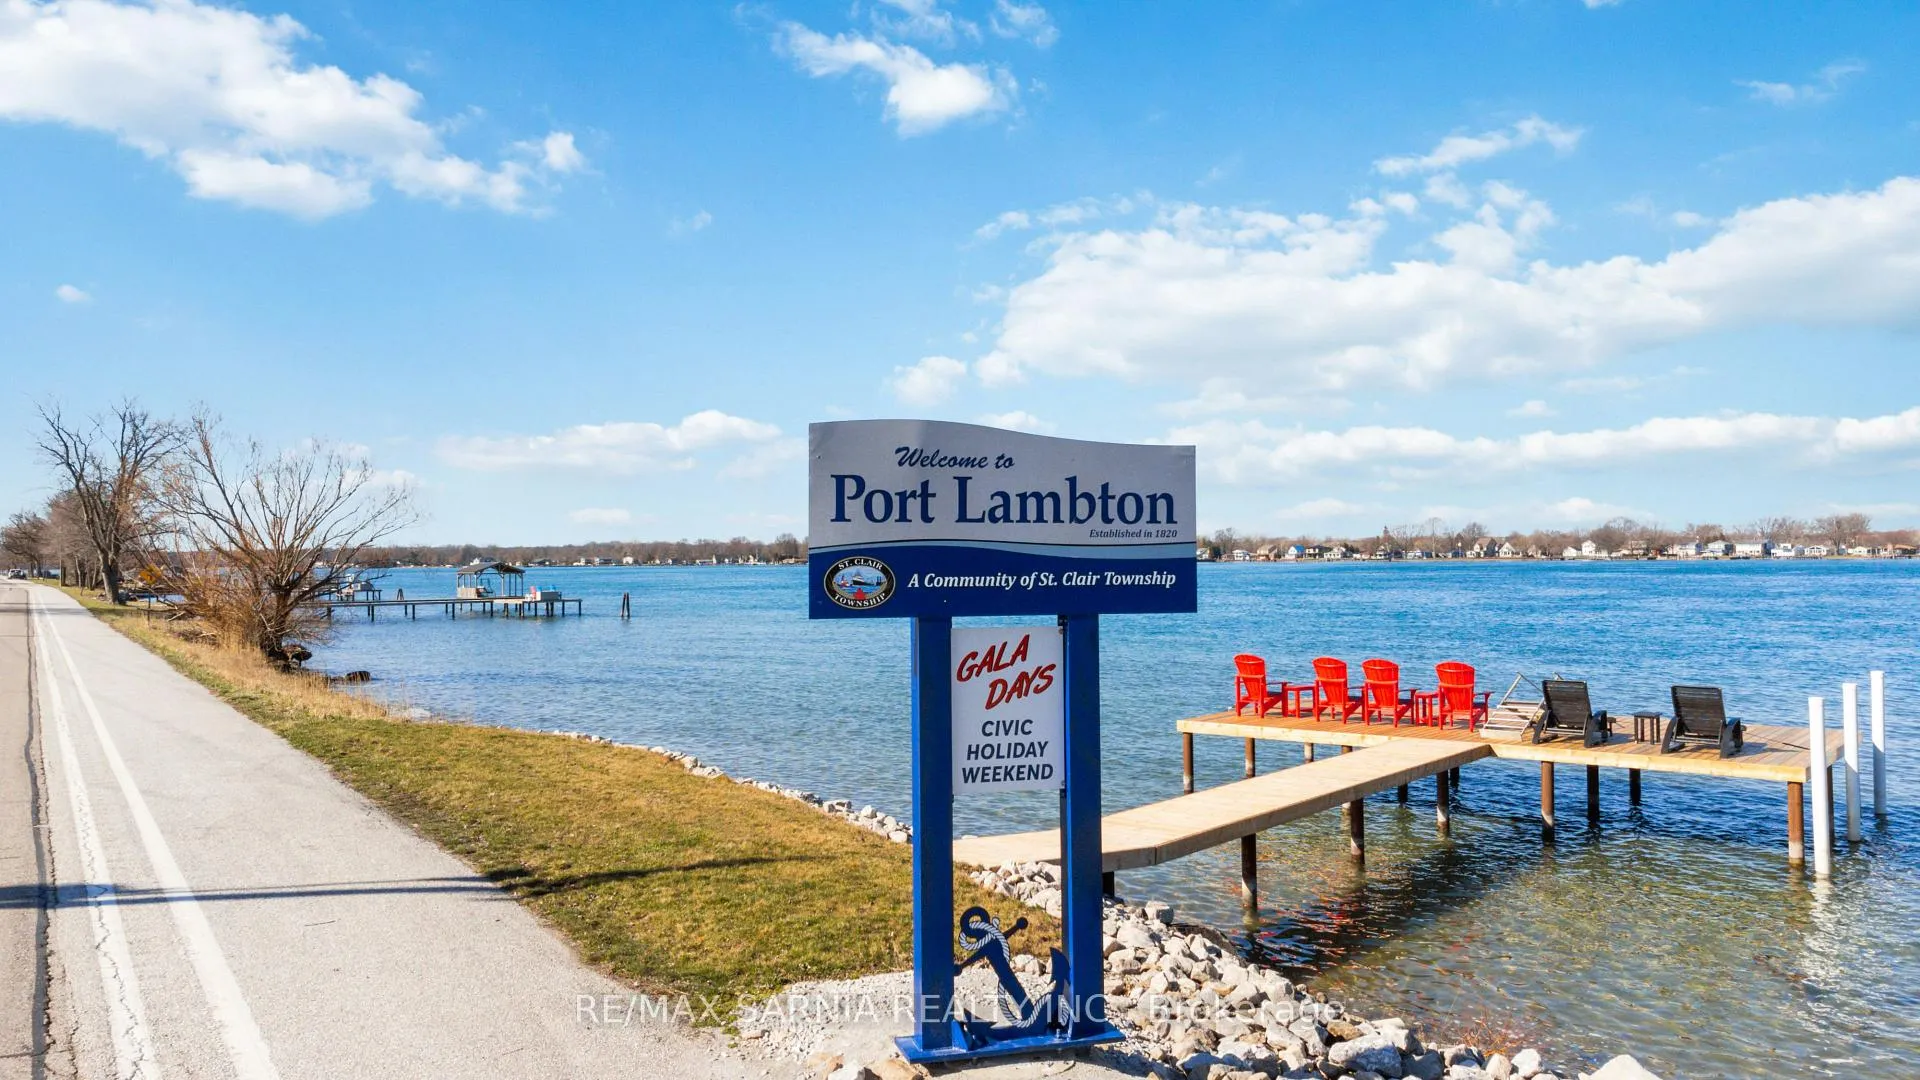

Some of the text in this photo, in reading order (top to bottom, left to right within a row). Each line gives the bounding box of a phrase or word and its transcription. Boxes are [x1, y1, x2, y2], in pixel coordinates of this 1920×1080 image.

[894, 446, 1015, 469] Welcome to
[830, 474, 1178, 525] Port Lambton
[1089, 529, 1178, 538] Established in 1820
[838, 558, 883, 570] ST. CLAIR
[907, 571, 1176, 590] A Community of St. Clair Township
[834, 592, 886, 607] TOWNSHIP
[956, 634, 1031, 682] GALA
[985, 663, 1057, 710] DAYS
[981, 719, 1034, 737] CIVIC
[966, 741, 1049, 761] HOLIDAY
[962, 763, 1054, 783] WEEKEND
